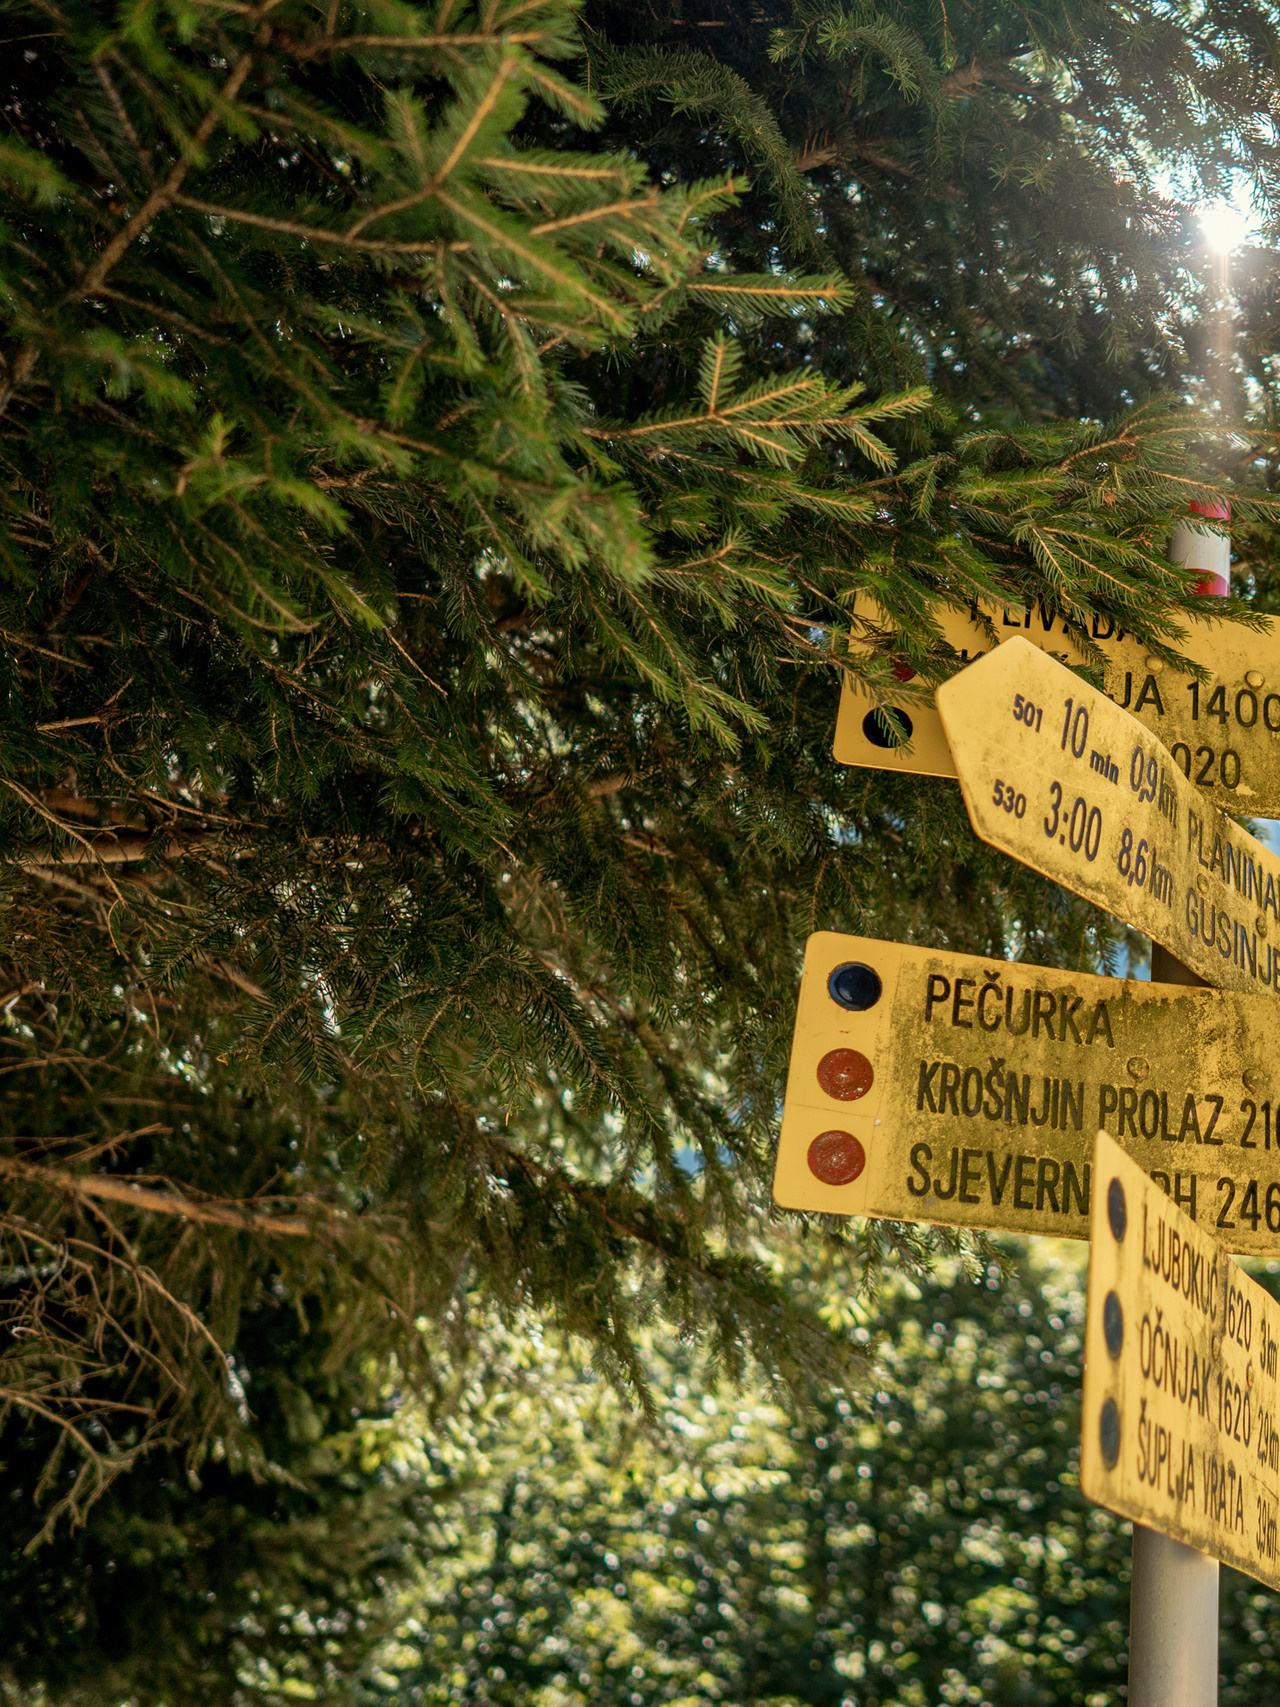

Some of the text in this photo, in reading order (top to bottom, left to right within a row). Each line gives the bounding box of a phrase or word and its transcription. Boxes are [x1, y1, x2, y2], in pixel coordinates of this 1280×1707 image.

[1013, 693, 1043, 733] 501
[1061, 697, 1089, 759] 10
[1089, 749, 1119, 785] min
[992, 778, 1027, 819] 530
[1044, 781, 1102, 862] 3:00
[924, 969, 1115, 1048] PEČURKA
[917, 1056, 1084, 1131] KROŠNJIN
[1099, 1083, 1225, 1146] PROLAZ
[907, 1142, 1091, 1217] SJEVERN
[1140, 1304, 1212, 1422] OČNJAK
[1217, 1371, 1251, 1448] 1620
[1137, 1396, 1196, 1508] ŠUPLJA
[1203, 1451, 1244, 1536] VRATA
